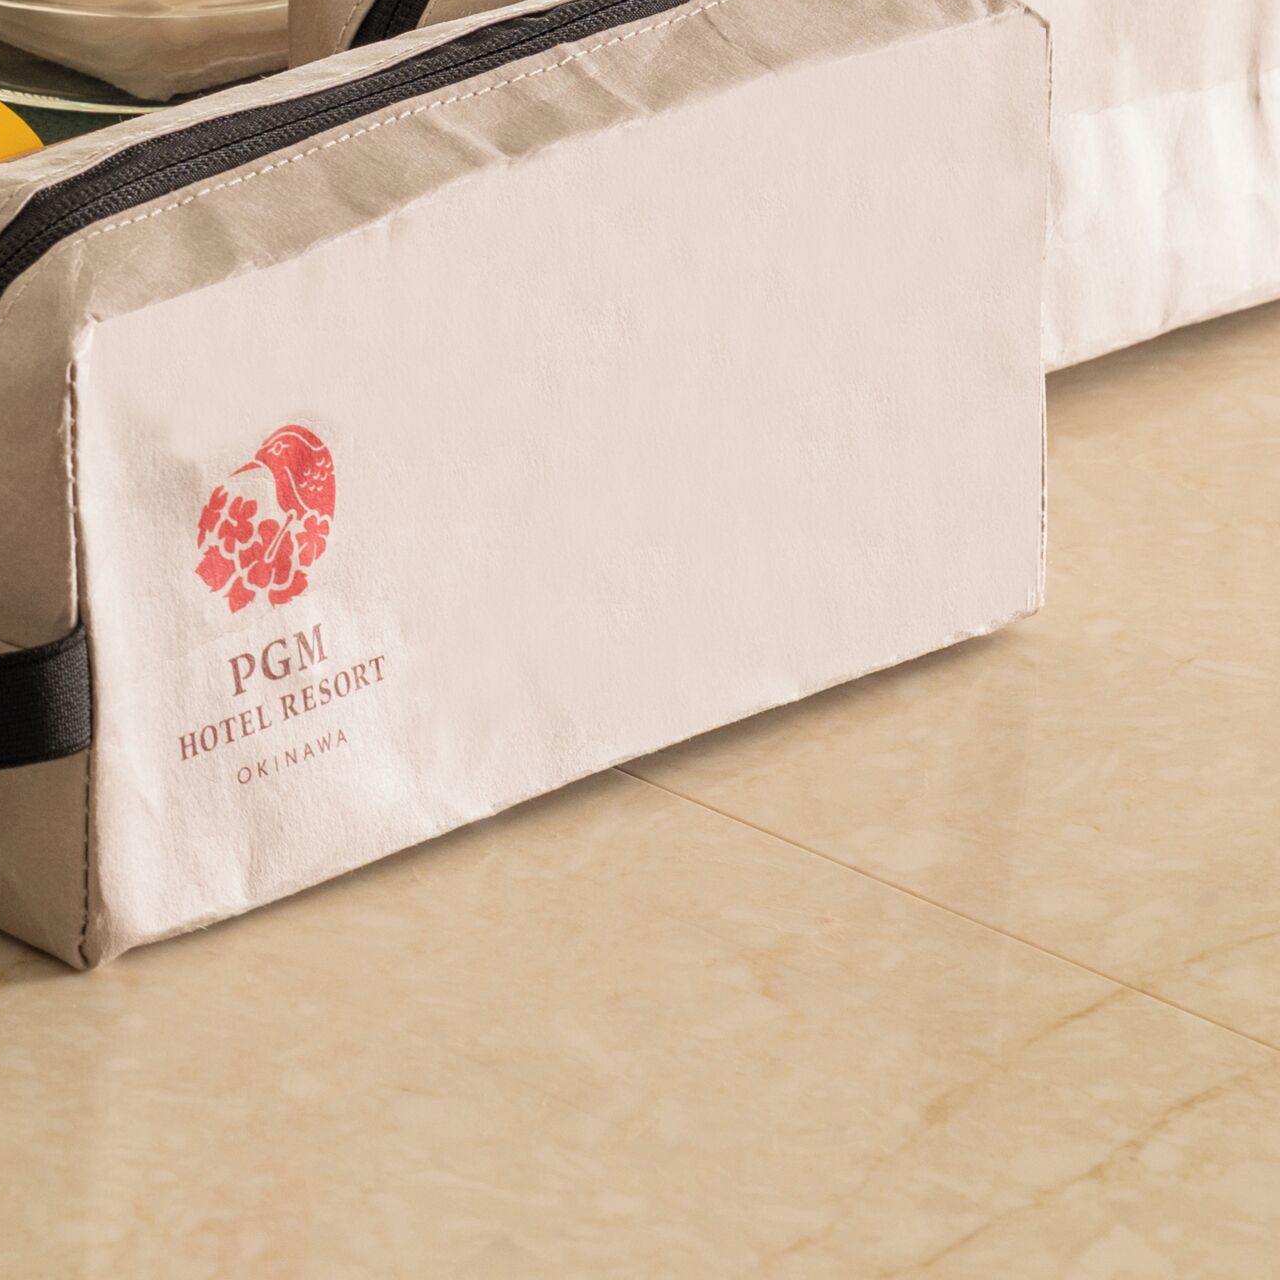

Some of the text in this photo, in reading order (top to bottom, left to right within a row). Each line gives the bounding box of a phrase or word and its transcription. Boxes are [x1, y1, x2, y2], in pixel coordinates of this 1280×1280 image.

[227, 623, 328, 698] PGM
[178, 655, 387, 761] HOTEL RESORT
[236, 728, 350, 785] OKINAWA
